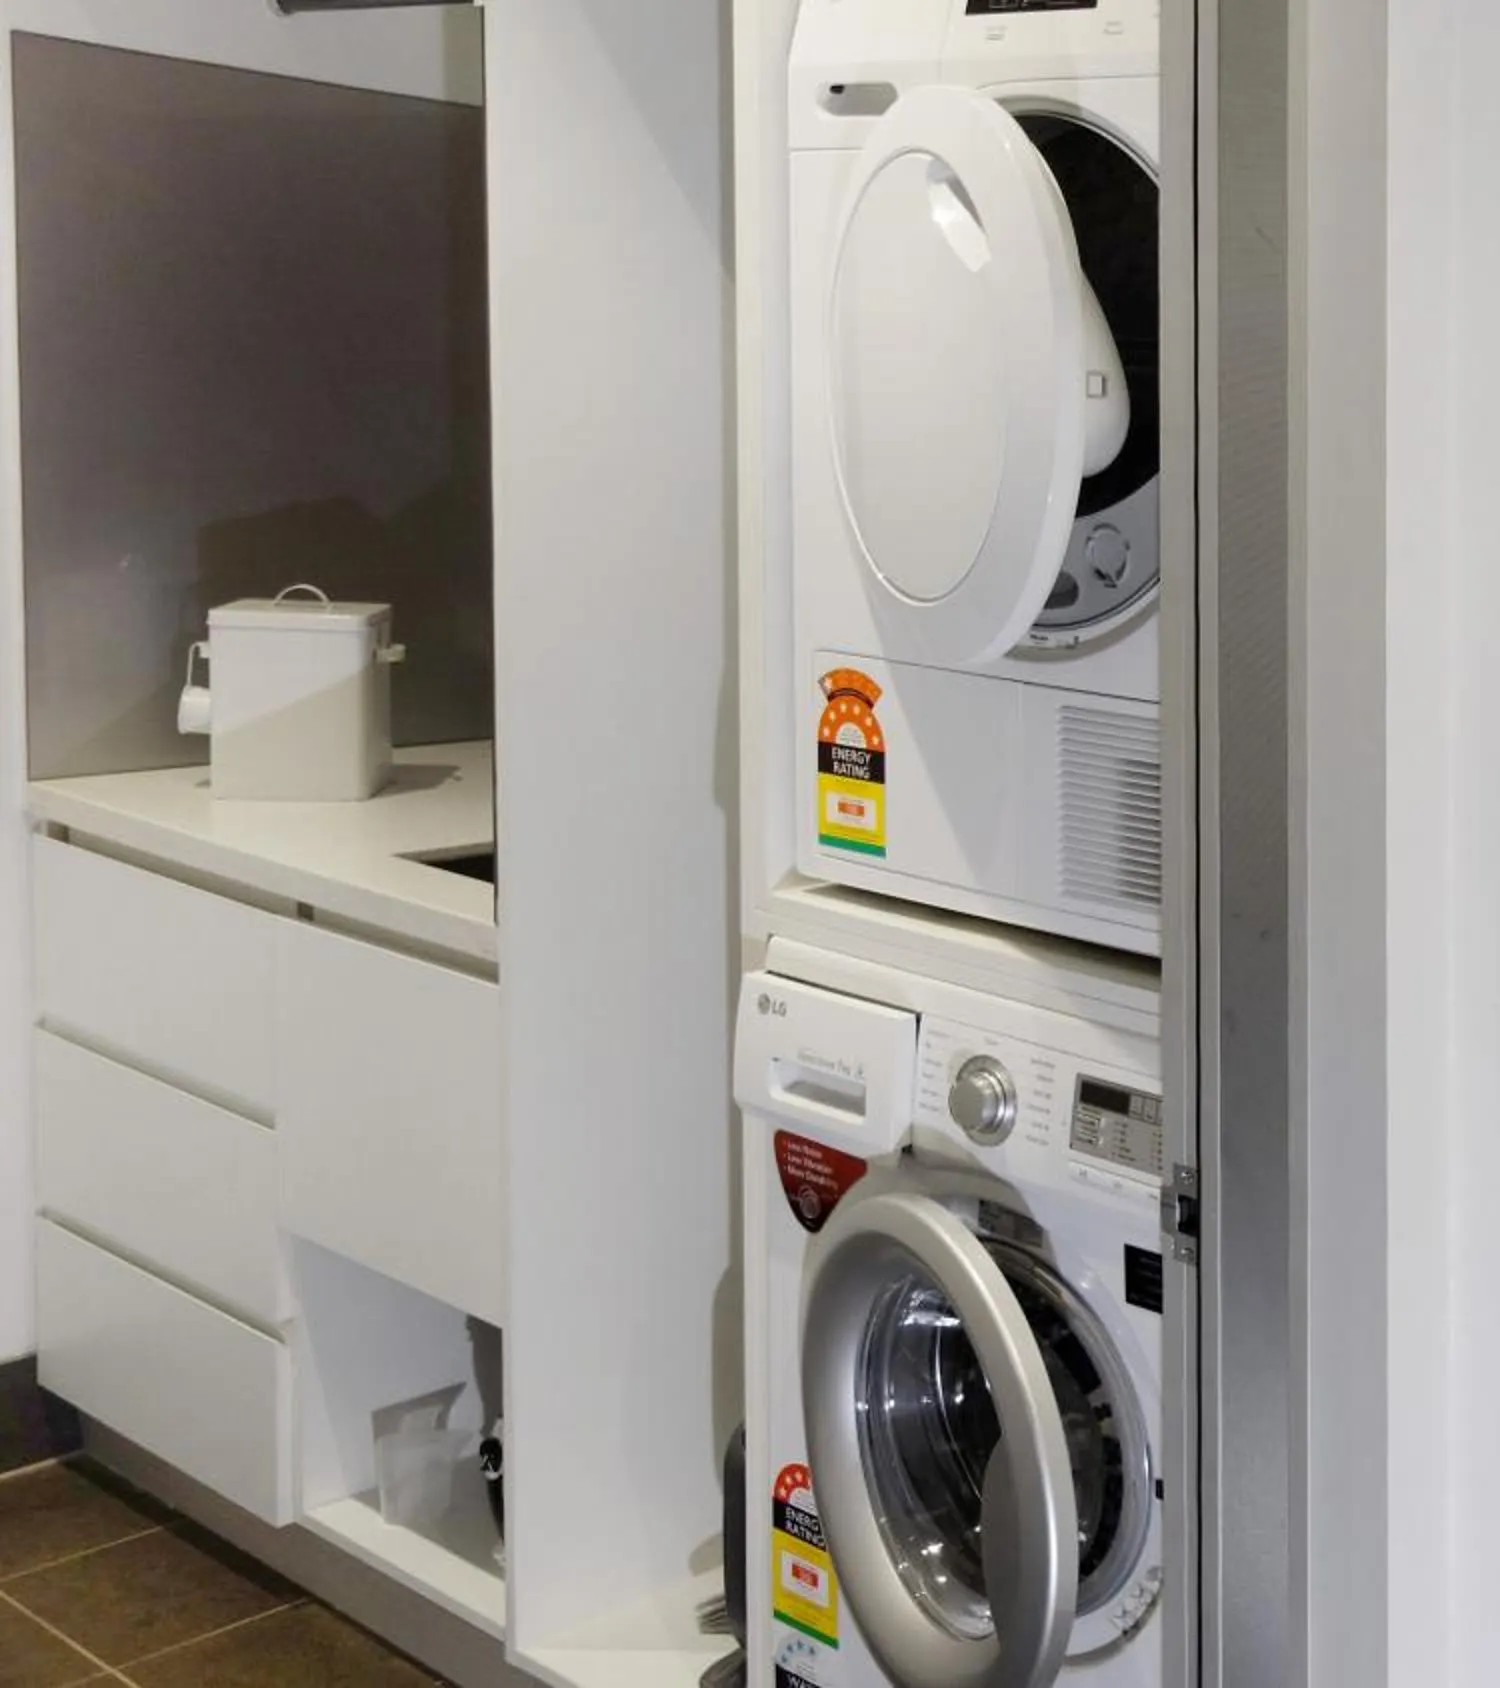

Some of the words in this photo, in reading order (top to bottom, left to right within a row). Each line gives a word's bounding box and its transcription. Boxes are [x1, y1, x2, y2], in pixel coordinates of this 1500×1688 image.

[831, 747, 871, 766] ENERGY
[833, 761, 870, 779] RATING
[772, 999, 787, 1018] LG
[785, 1506, 820, 1533] ENERG
